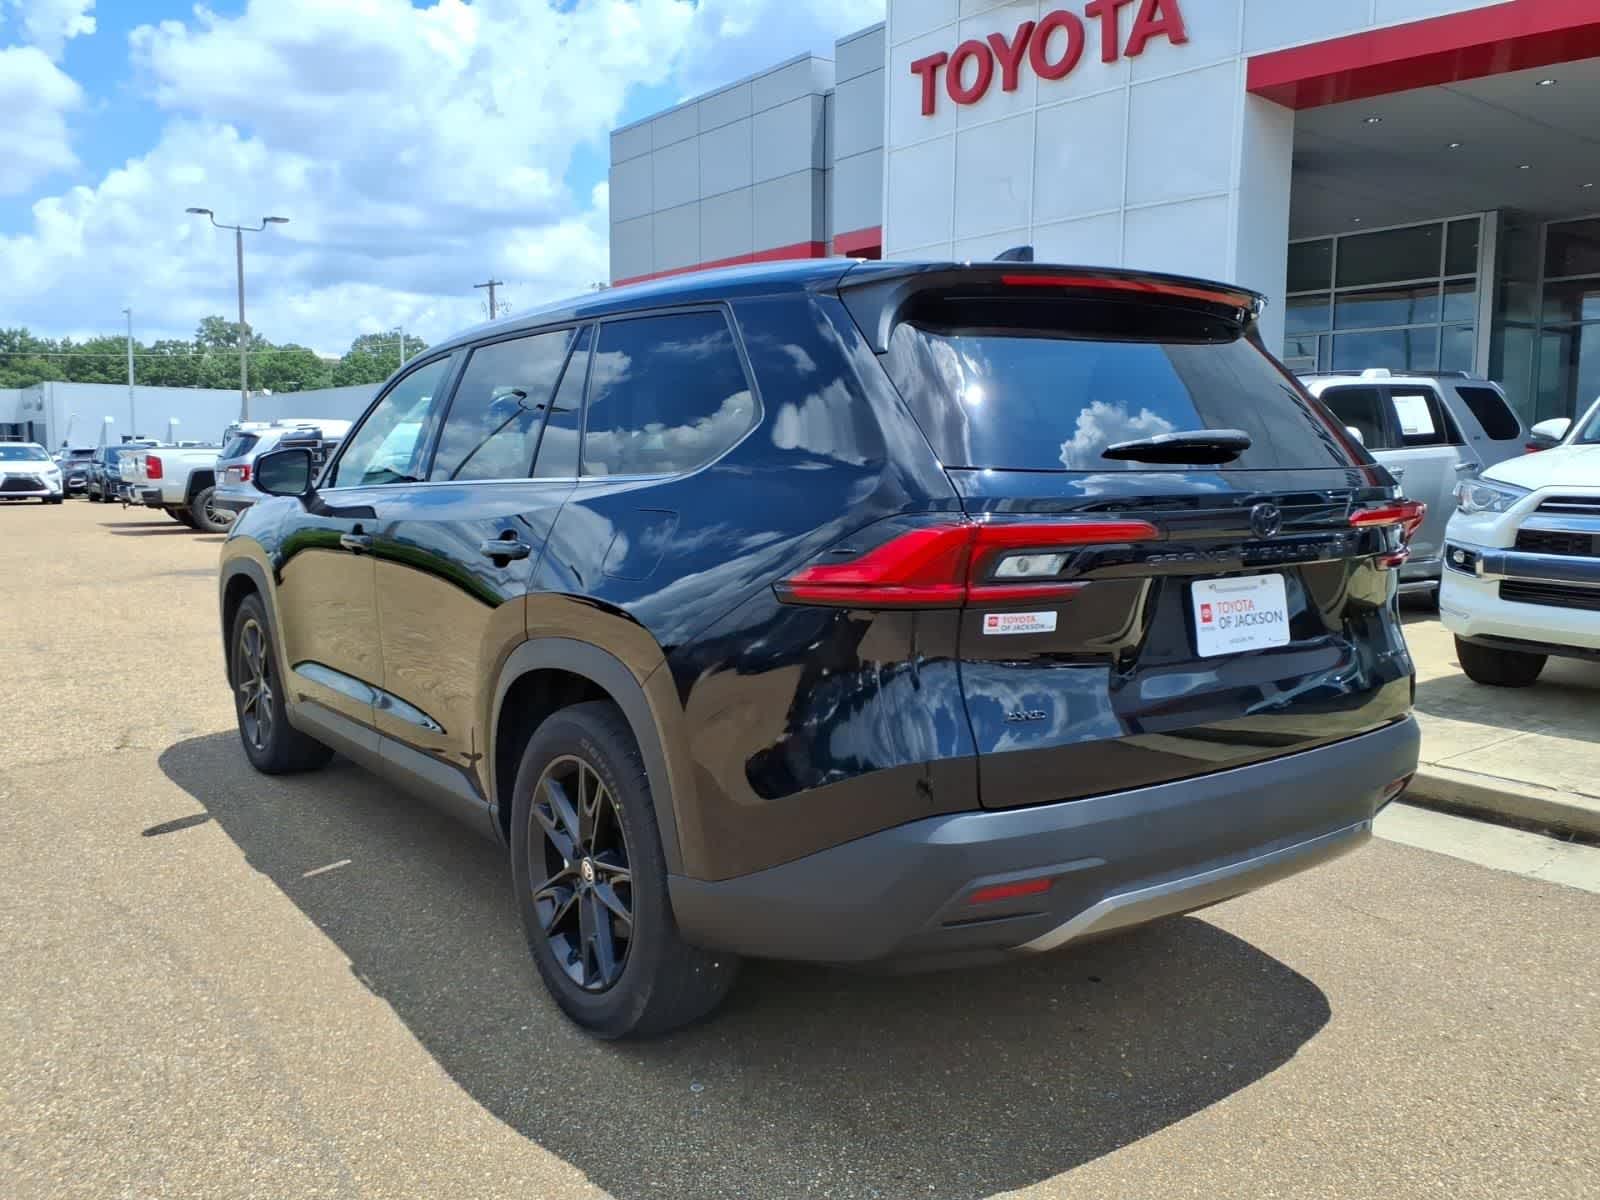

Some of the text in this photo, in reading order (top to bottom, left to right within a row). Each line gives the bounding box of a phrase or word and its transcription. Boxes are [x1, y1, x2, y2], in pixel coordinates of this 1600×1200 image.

[911, 0, 1189, 116] TOYOTA
[1216, 599, 1255, 614] TOYOTA
[1002, 615, 1036, 625] TOYOTA
[1219, 610, 1284, 629] OF JACKSON
